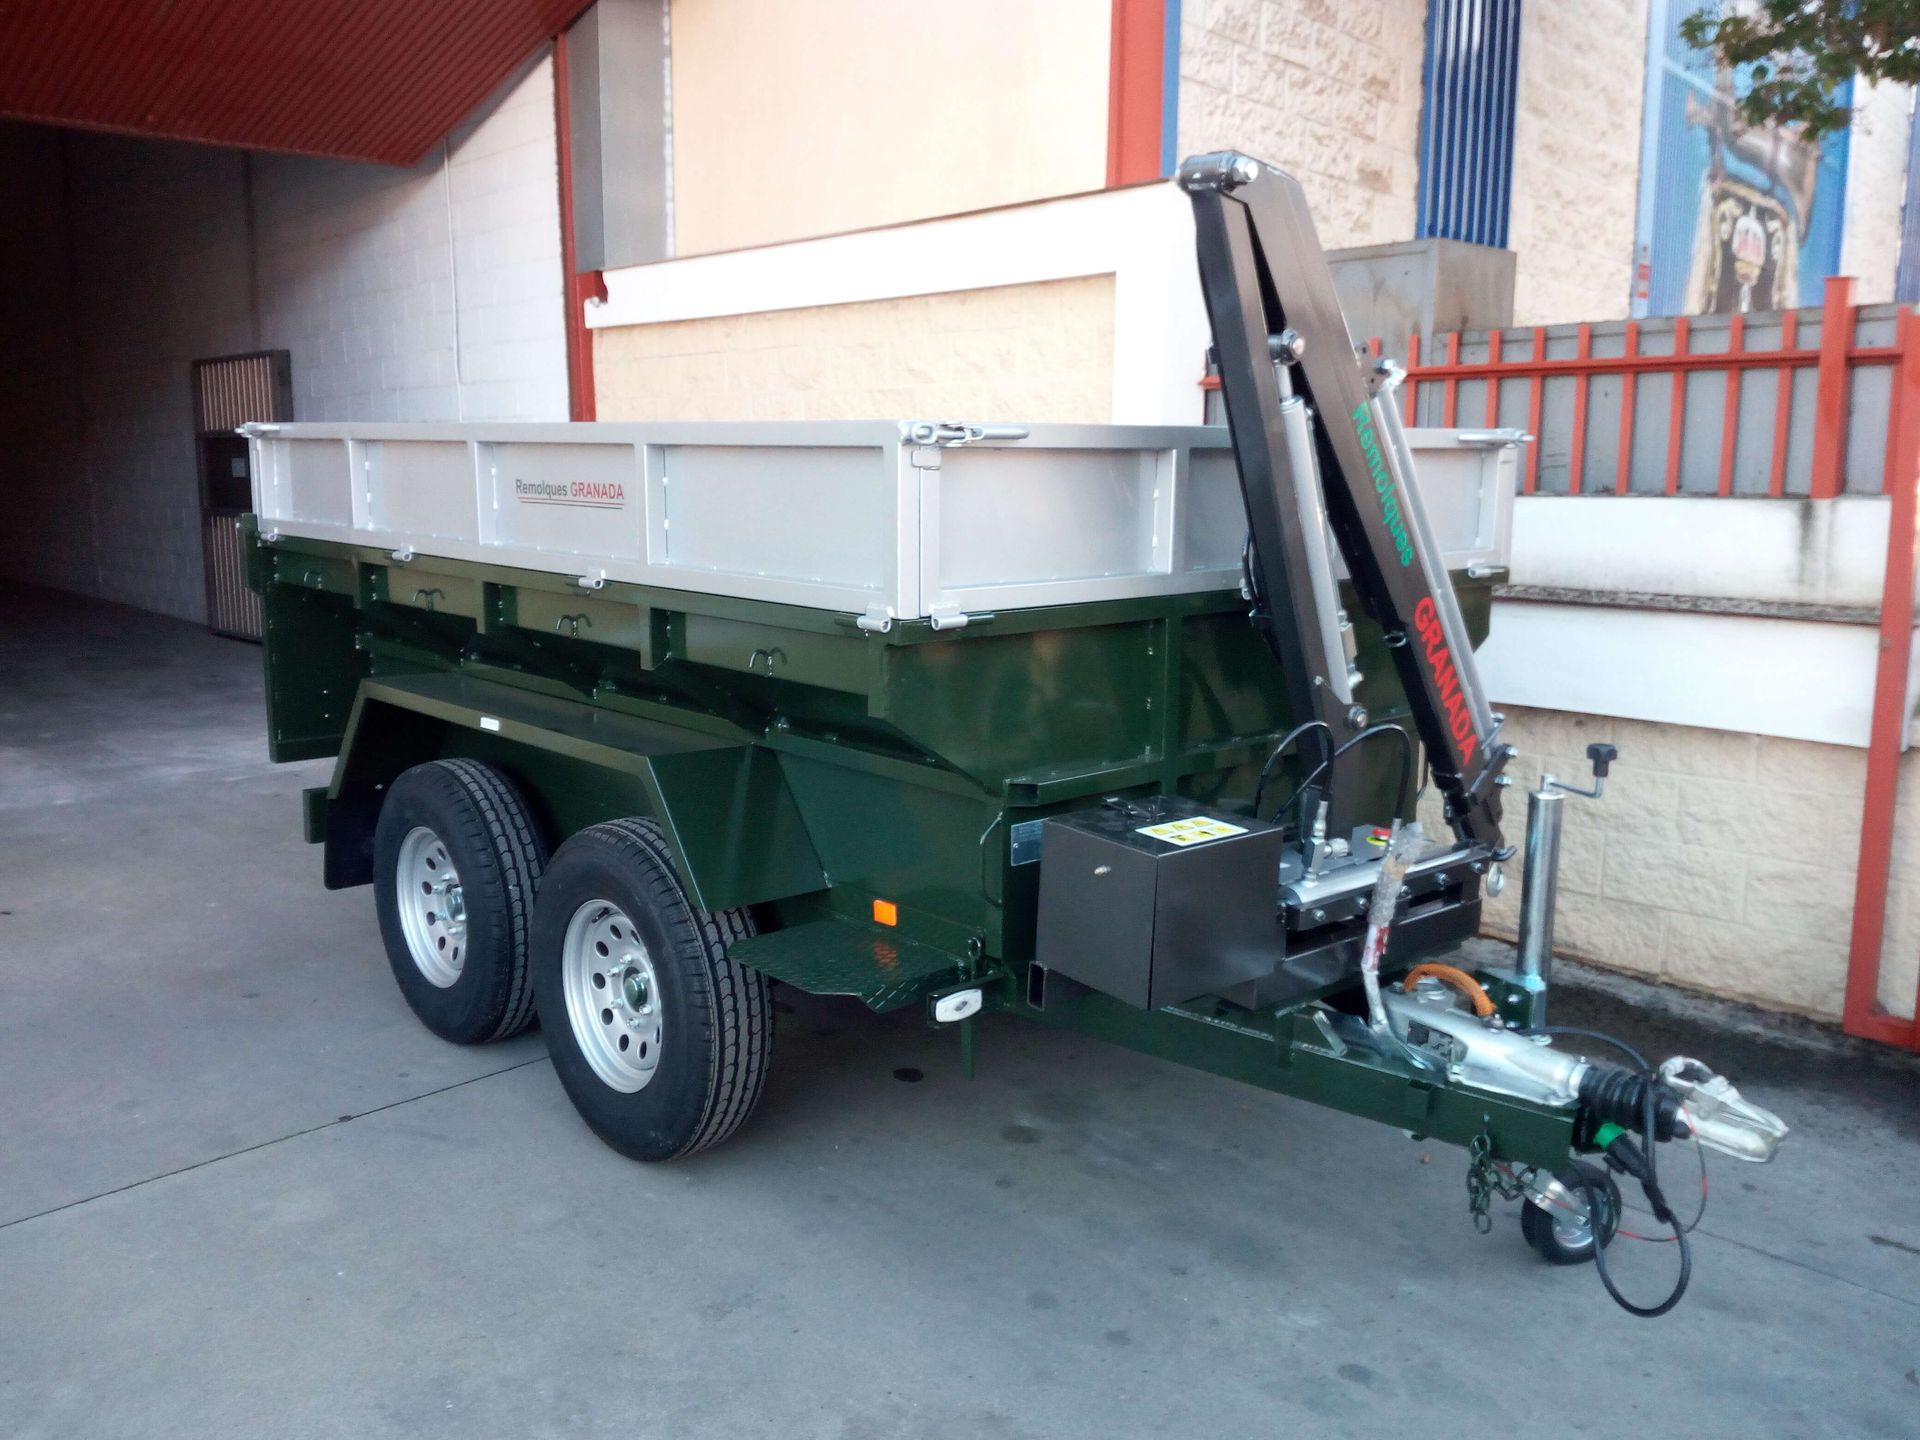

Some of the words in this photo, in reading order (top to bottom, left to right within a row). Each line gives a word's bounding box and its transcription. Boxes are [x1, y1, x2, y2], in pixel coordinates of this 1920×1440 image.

[515, 479, 568, 499] Remolques
[570, 482, 625, 500] GRANADA
[1351, 400, 1413, 567] Remolques
[1414, 597, 1479, 766] GRANADA
